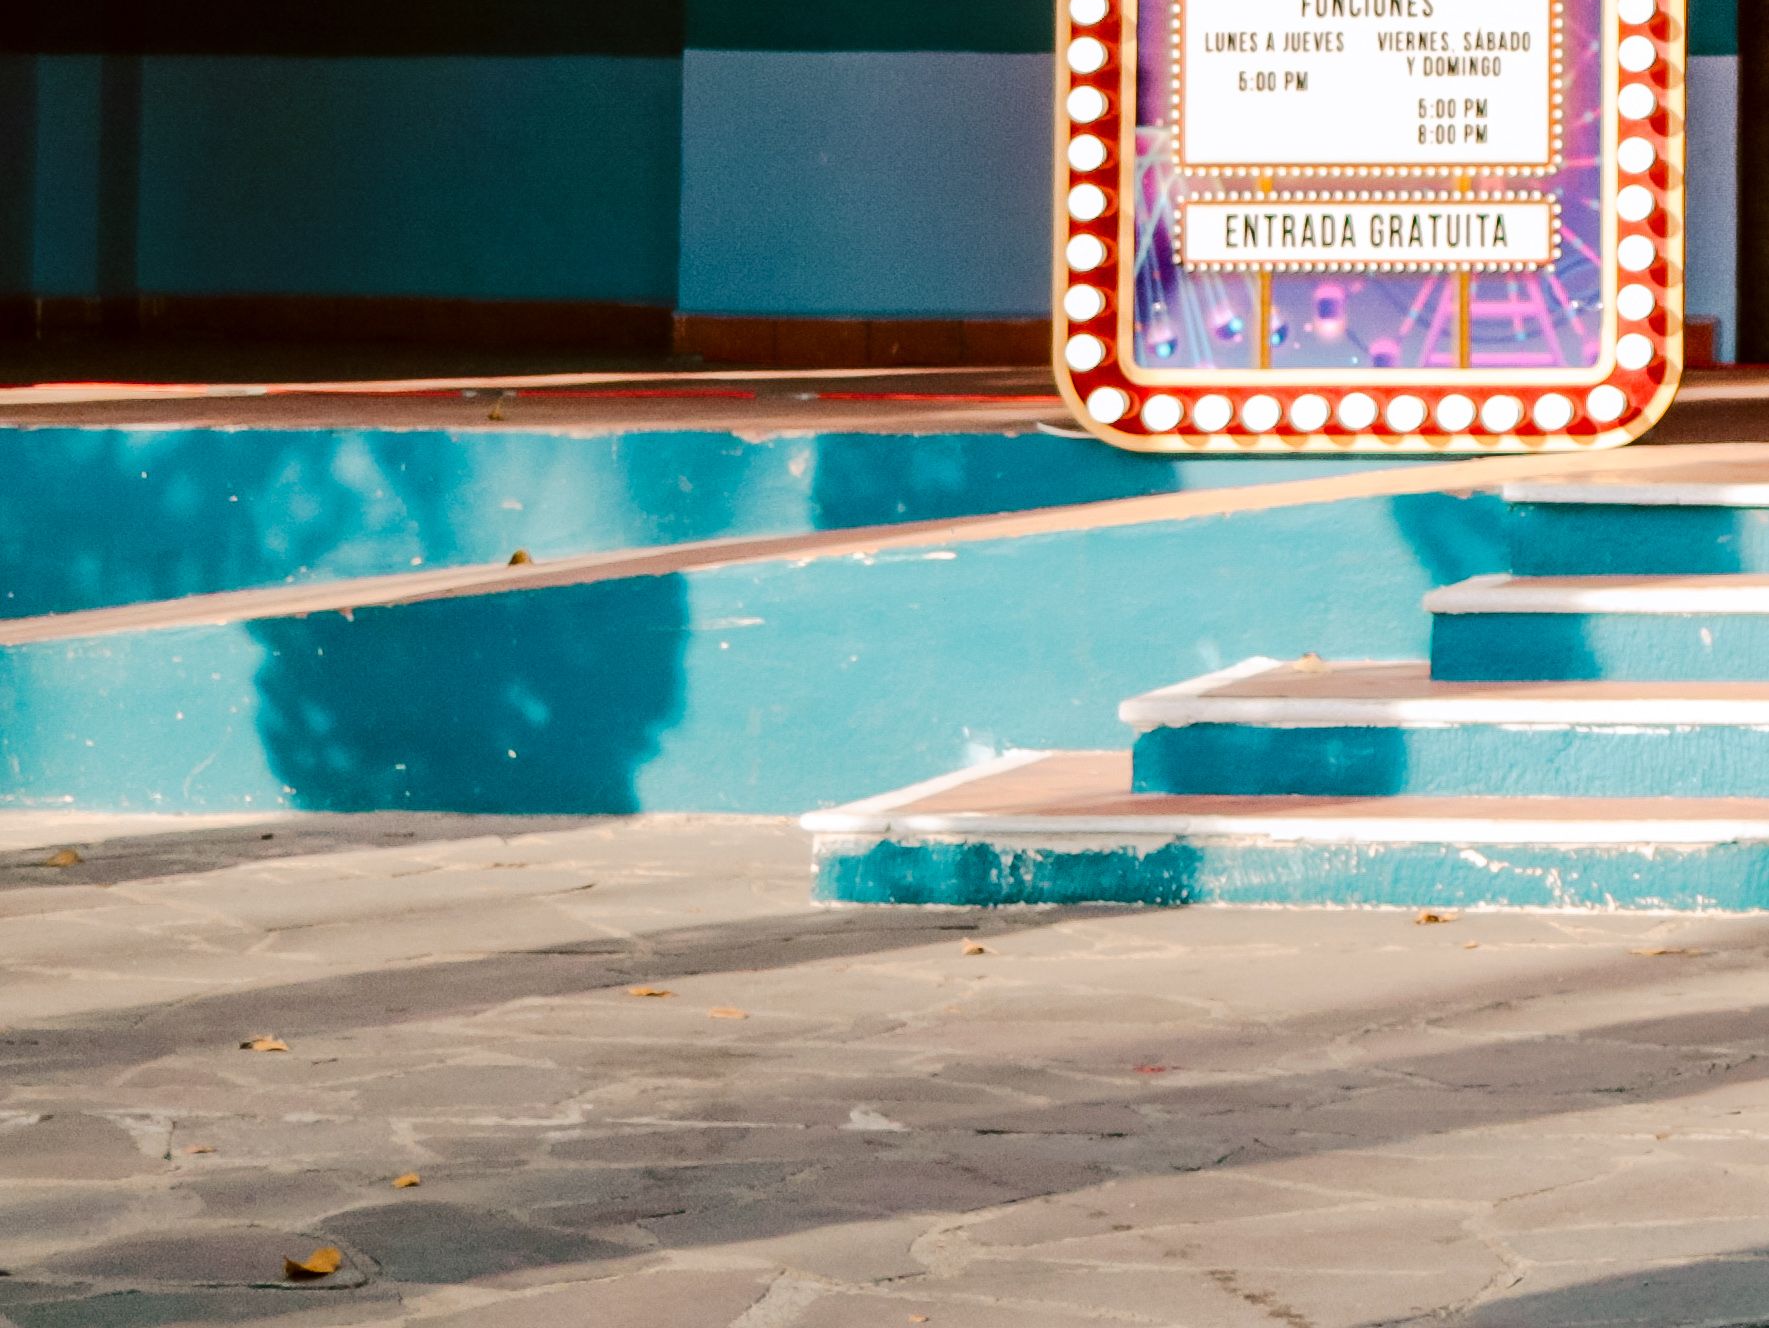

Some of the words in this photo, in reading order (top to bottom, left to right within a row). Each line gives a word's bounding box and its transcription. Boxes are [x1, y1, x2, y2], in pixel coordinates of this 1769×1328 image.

[1204, 31, 1258, 53] LUNES
[1265, 31, 1275, 52] A
[1282, 31, 1345, 53] JUEVES
[1462, 27, 1532, 53] SÁBADO
[1406, 56, 1416, 76] Y
[1423, 55, 1501, 77] DOMINGO
[1238, 70, 1277, 92] 5:00
[1284, 71, 1308, 91] PM
[1418, 97, 1457, 120] 5:00
[1464, 98, 1488, 119] PM
[1417, 123, 1456, 145] 8:00
[1464, 123, 1488, 144] PM
[1225, 213, 1356, 248] ENTRADA
[1369, 213, 1508, 249] GRATUITA
